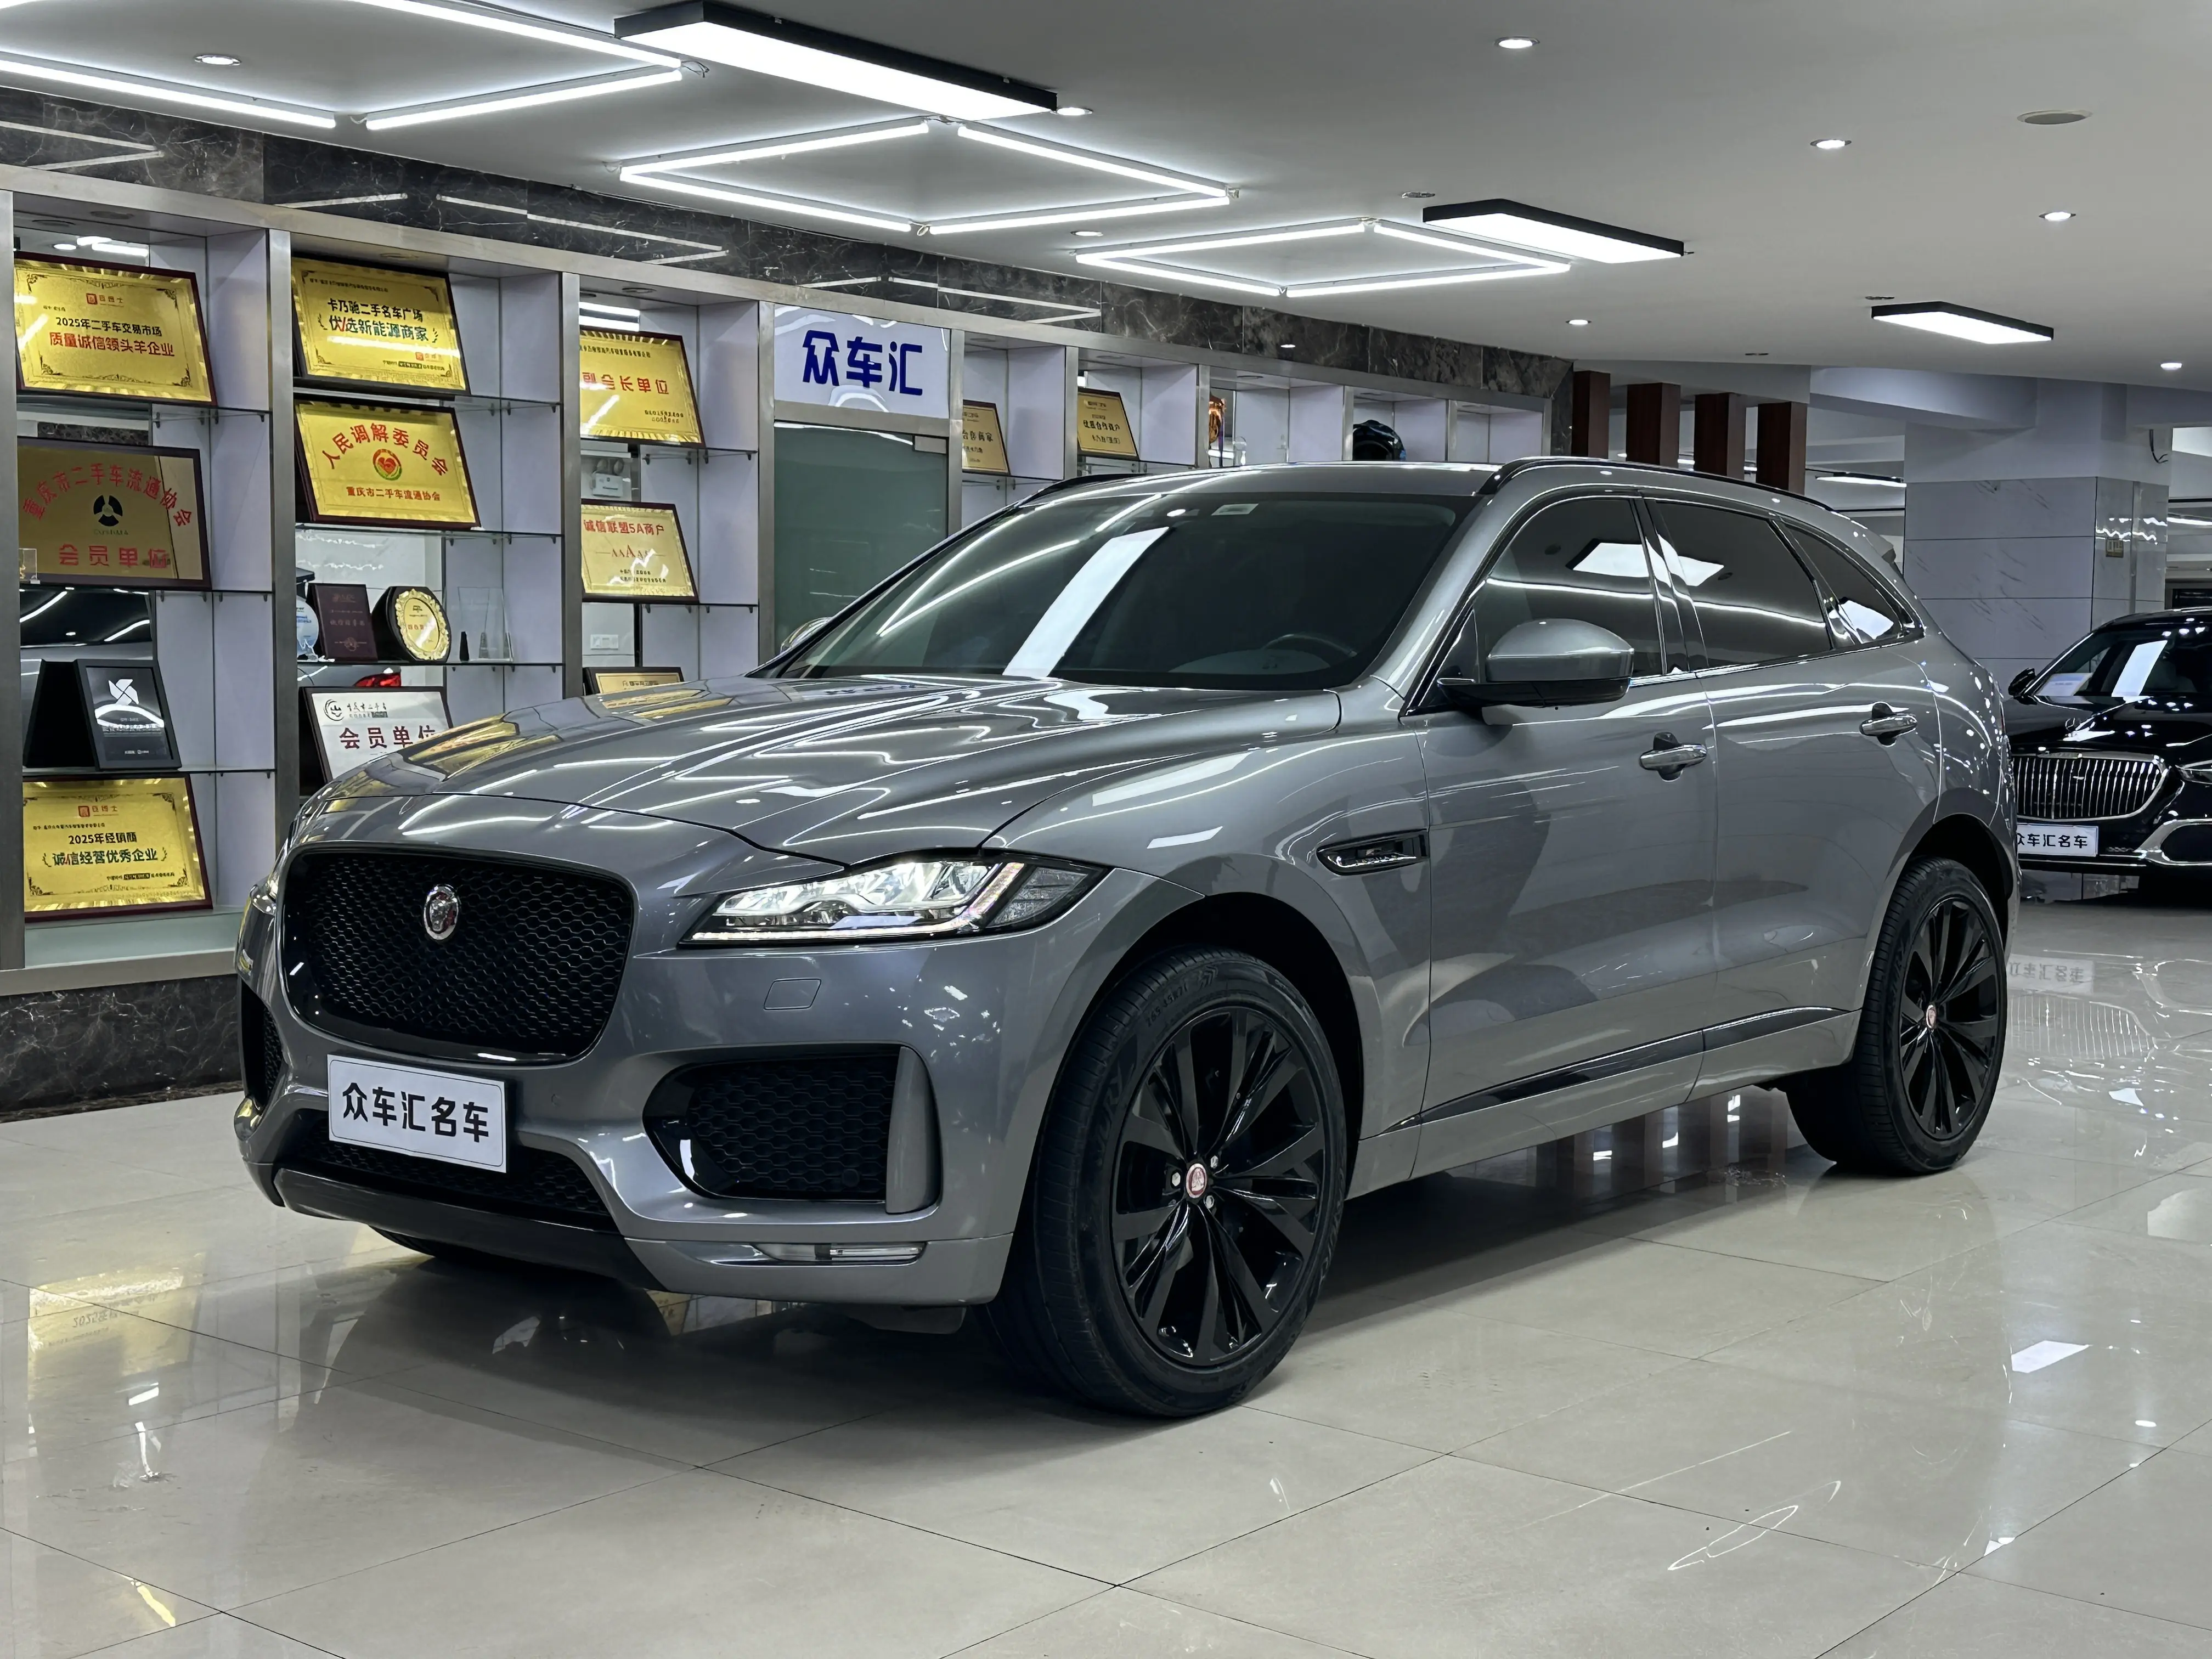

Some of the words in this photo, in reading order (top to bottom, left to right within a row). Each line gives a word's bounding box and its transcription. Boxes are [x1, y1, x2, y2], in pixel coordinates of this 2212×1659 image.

[328, 298, 423, 323] 卡乃驰二手名车广场
[55, 317, 163, 337] 2025年二手车交易市场
[49, 331, 175, 357] 质量诚信领头羊企业
[802, 330, 923, 396] 众车汇
[322, 422, 449, 476] 人民调解委员会
[23, 463, 191, 527] 重庆市二手车流通协会
[346, 486, 441, 501] 重庆市二手车流通协会
[584, 520, 664, 535] 诚信联盟5A商户
[59, 543, 170, 569] 会员单位
[339, 725, 436, 749] 会员单位
[53, 848, 158, 866] 诚信经营优秀企业
[342, 1082, 489, 1143] 众车汇名车
